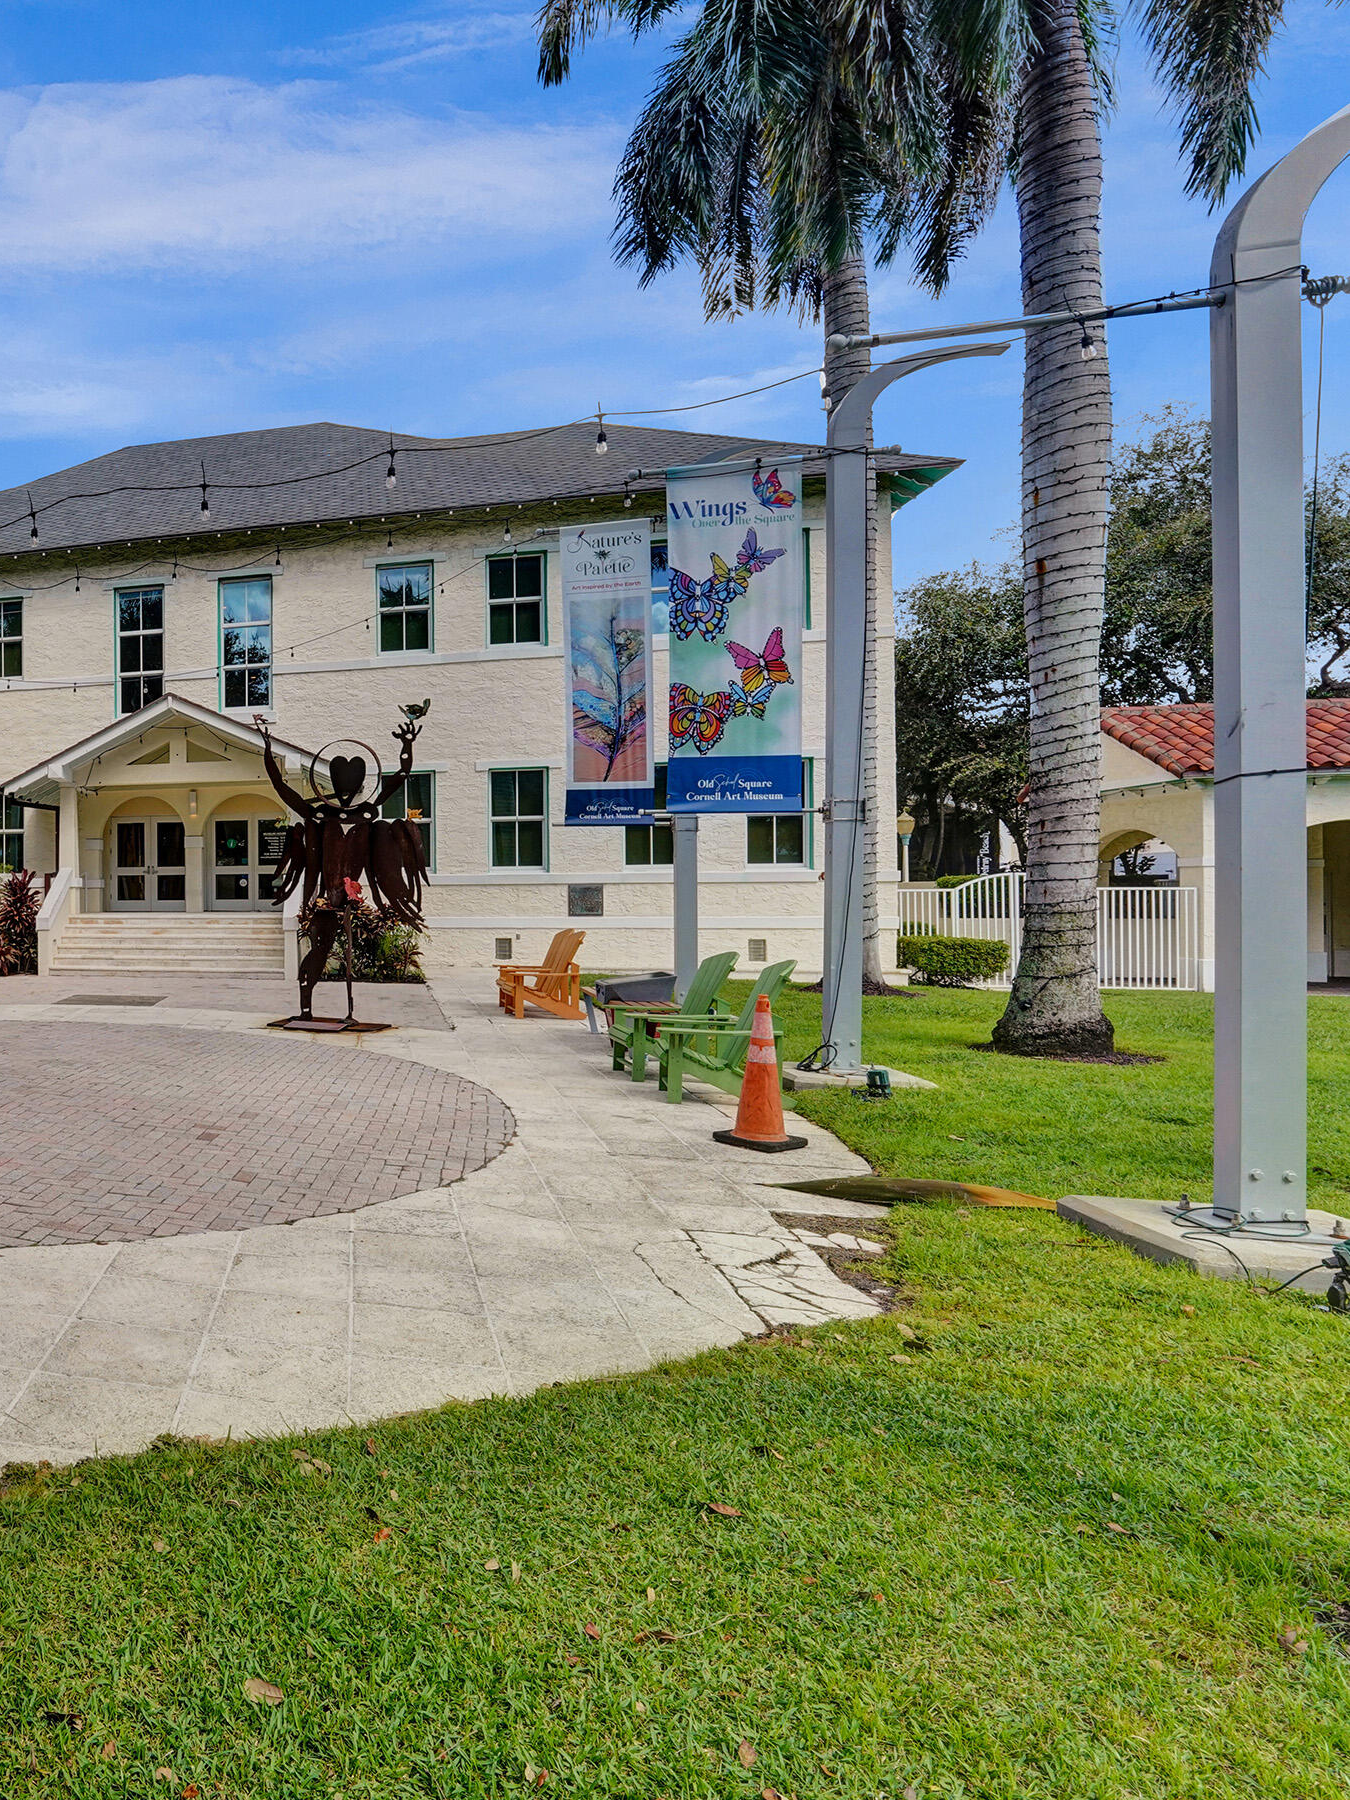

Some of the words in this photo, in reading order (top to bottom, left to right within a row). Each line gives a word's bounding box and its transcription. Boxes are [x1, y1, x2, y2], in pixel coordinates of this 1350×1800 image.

[668, 499, 747, 526] Wings
[692, 518, 721, 528] Over
[735, 516, 751, 526] the
[753, 513, 795, 526] Square
[567, 531, 642, 553] Nature's
[575, 556, 635, 576] Palette
[697, 779, 714, 789] Old
[738, 779, 772, 790] Square
[686, 791, 721, 802] Cornell
[723, 791, 741, 801] Art
[743, 790, 783, 801] Museum
[586, 804, 597, 812] Old
[611, 804, 634, 812] Square
[979, 831, 991, 854] Beach
